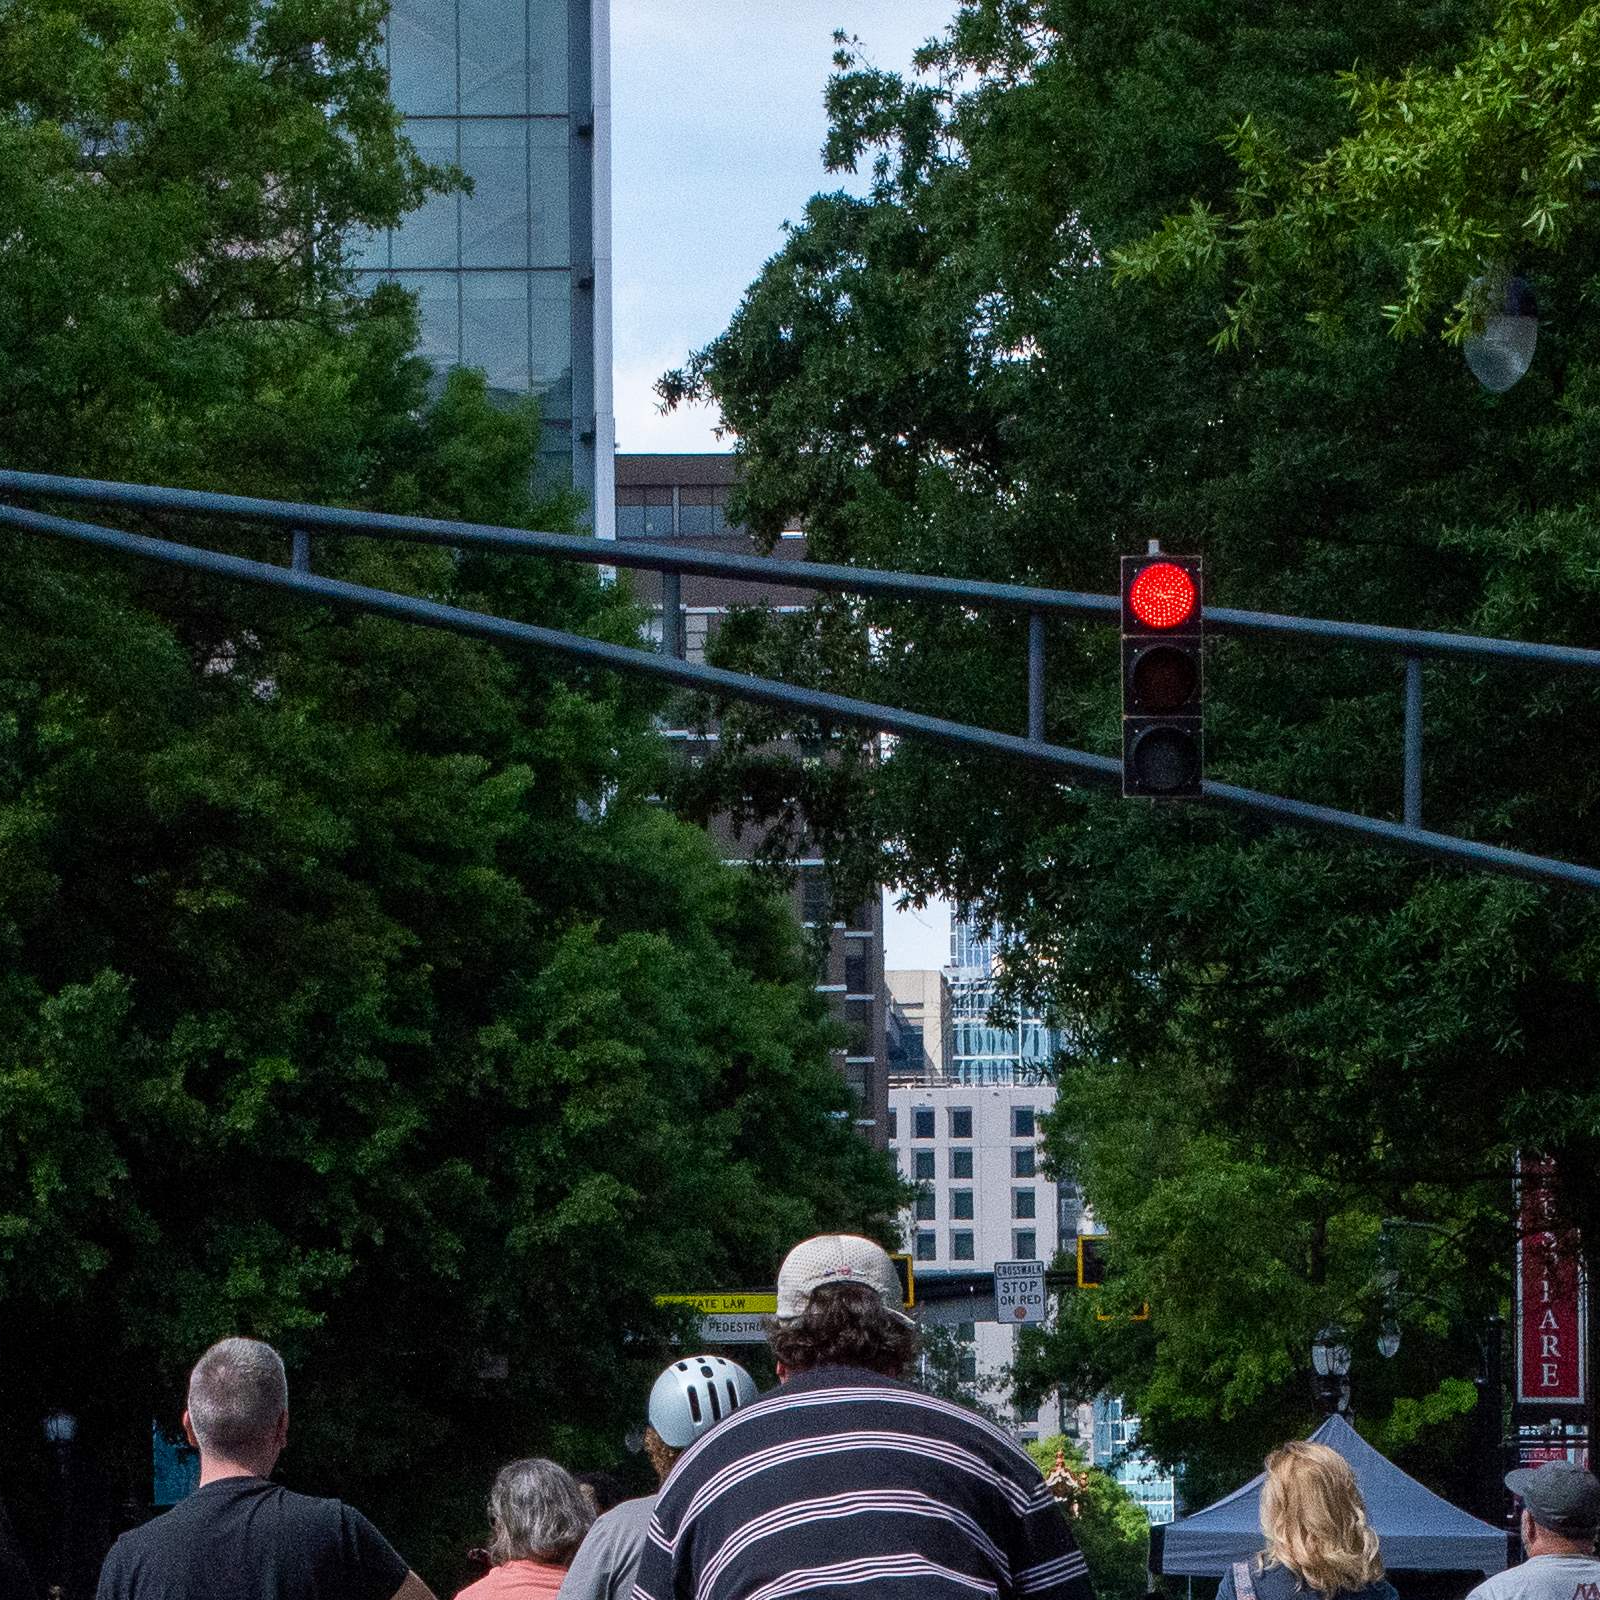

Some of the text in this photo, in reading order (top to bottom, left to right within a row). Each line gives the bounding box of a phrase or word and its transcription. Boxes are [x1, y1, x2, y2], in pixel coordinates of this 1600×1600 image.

[997, 1264, 1041, 1276] CROSSWALK
[1002, 1281, 1037, 1293] STOP
[723, 1299, 746, 1308] LAW
[1000, 1295, 1041, 1306] ON RED
